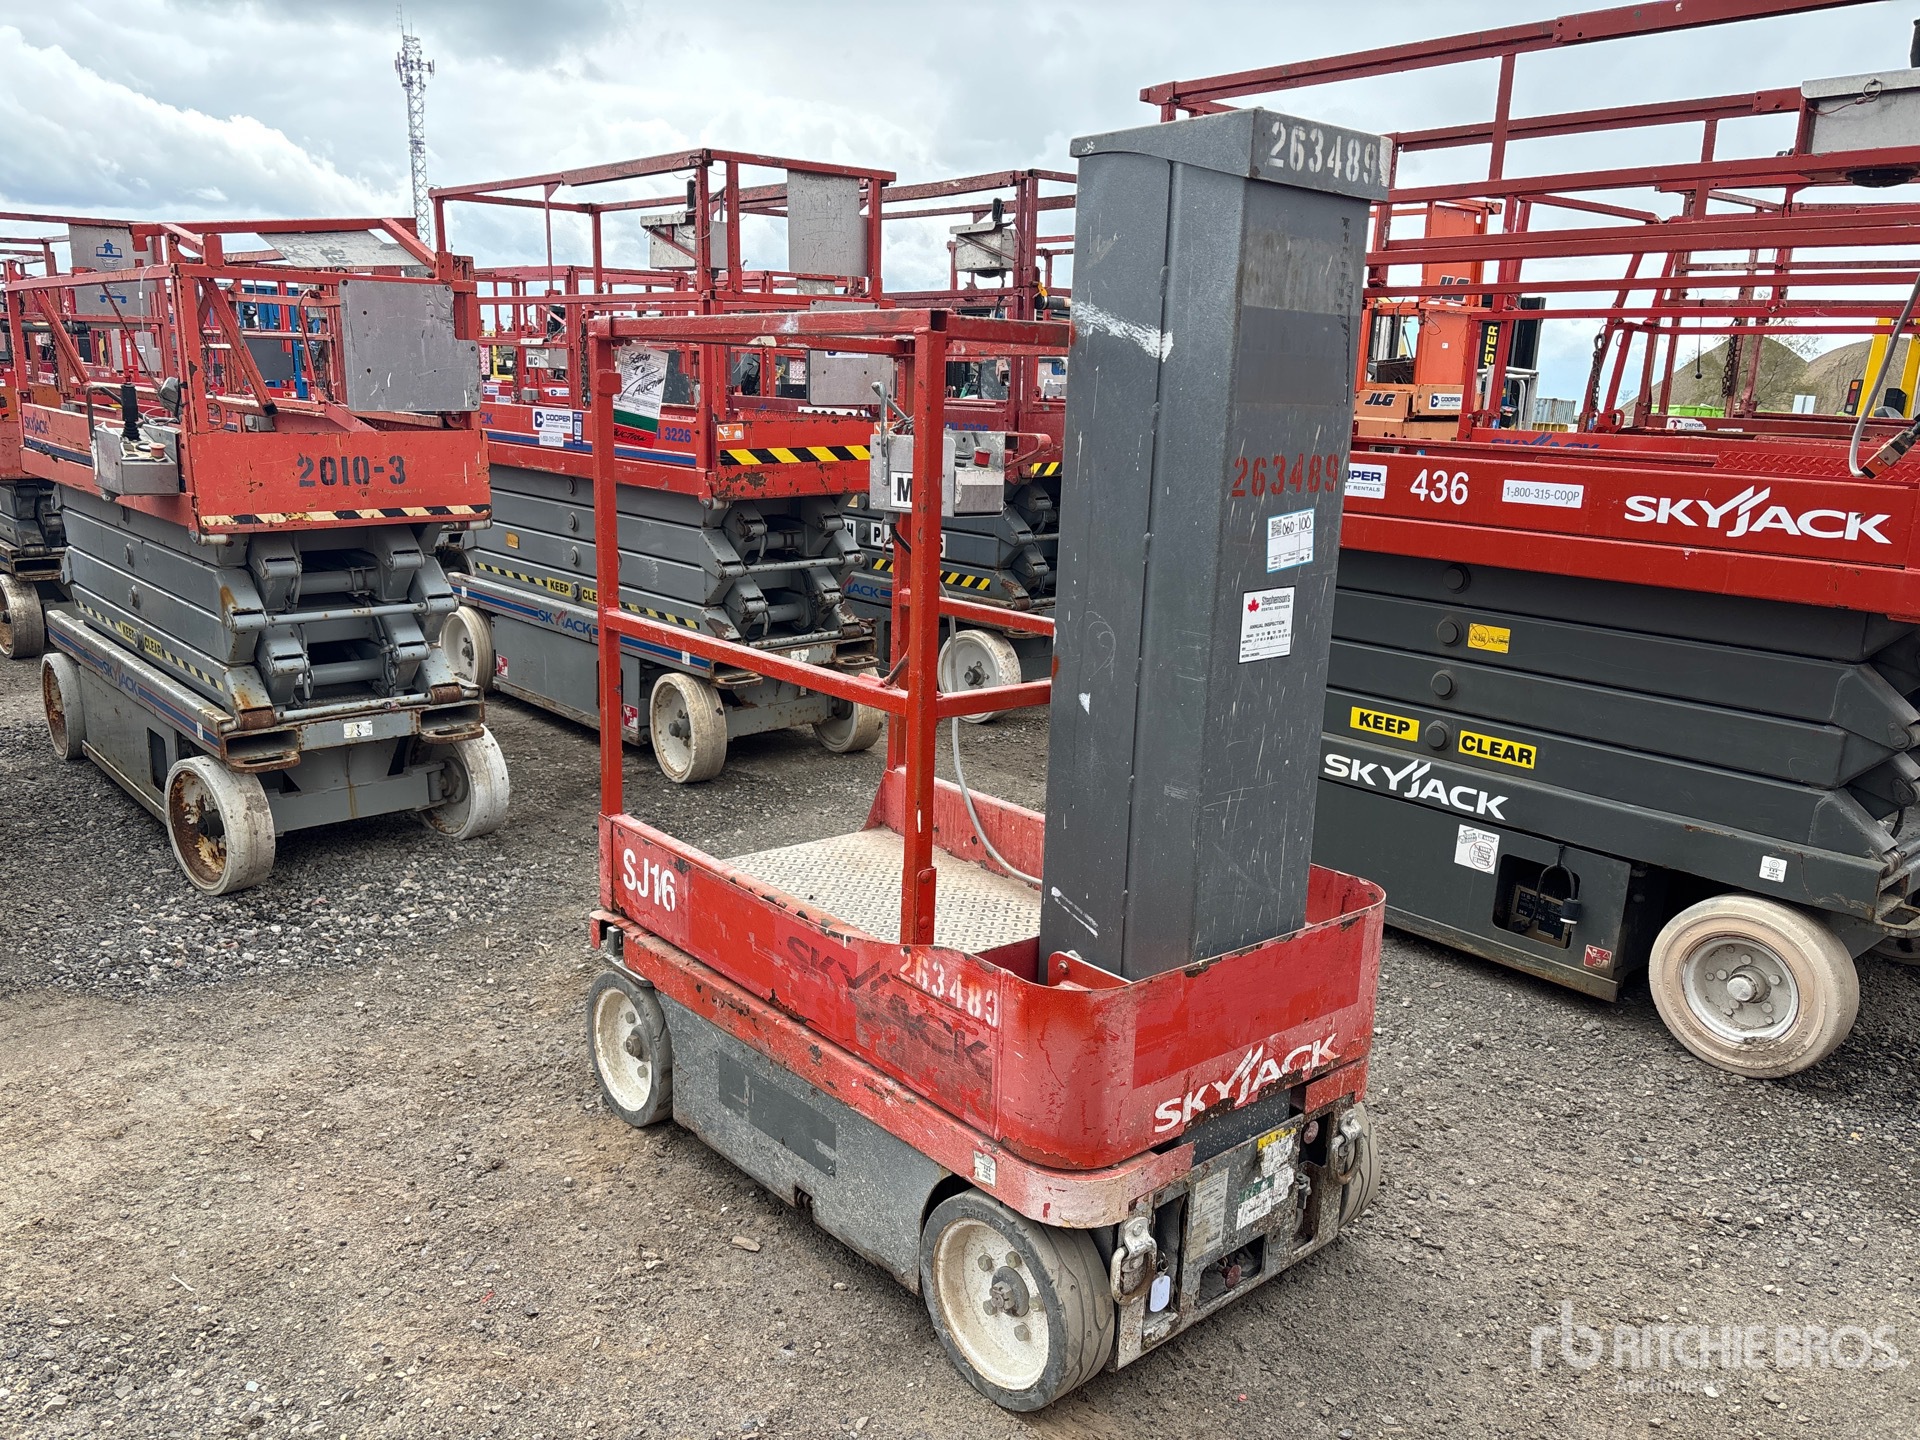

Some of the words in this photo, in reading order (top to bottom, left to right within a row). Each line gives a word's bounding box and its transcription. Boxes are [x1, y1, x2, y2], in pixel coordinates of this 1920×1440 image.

[1268, 121, 1378, 185] 263489
[528, 357, 538, 366] MC
[1365, 393, 1395, 406] JLG
[545, 413, 571, 422] COOPER
[665, 427, 691, 443] 3226
[297, 454, 406, 488] 2010-3
[1232, 453, 1338, 497] 263489
[1348, 471, 1382, 482] PER
[896, 477, 913, 502] M
[1353, 485, 1381, 493] RENTALS
[1410, 469, 1469, 505] 436
[1506, 486, 1580, 503] 1-800-315-COOP
[1624, 485, 1893, 544] SKYJACK
[550, 580, 569, 594] KEEP
[582, 589, 597, 601] CLE
[538, 609, 591, 634] SKYJACK
[144, 635, 162, 657] CLEAR
[102, 660, 139, 696] SKYJACK
[1359, 712, 1410, 735] KEEP
[1461, 735, 1533, 766] CLEAR
[1324, 753, 1509, 820] SKYJACK
[623, 848, 676, 912] SJ16
[899, 946, 999, 1028] 263489
[1154, 1033, 1341, 1133] SKYJACK
